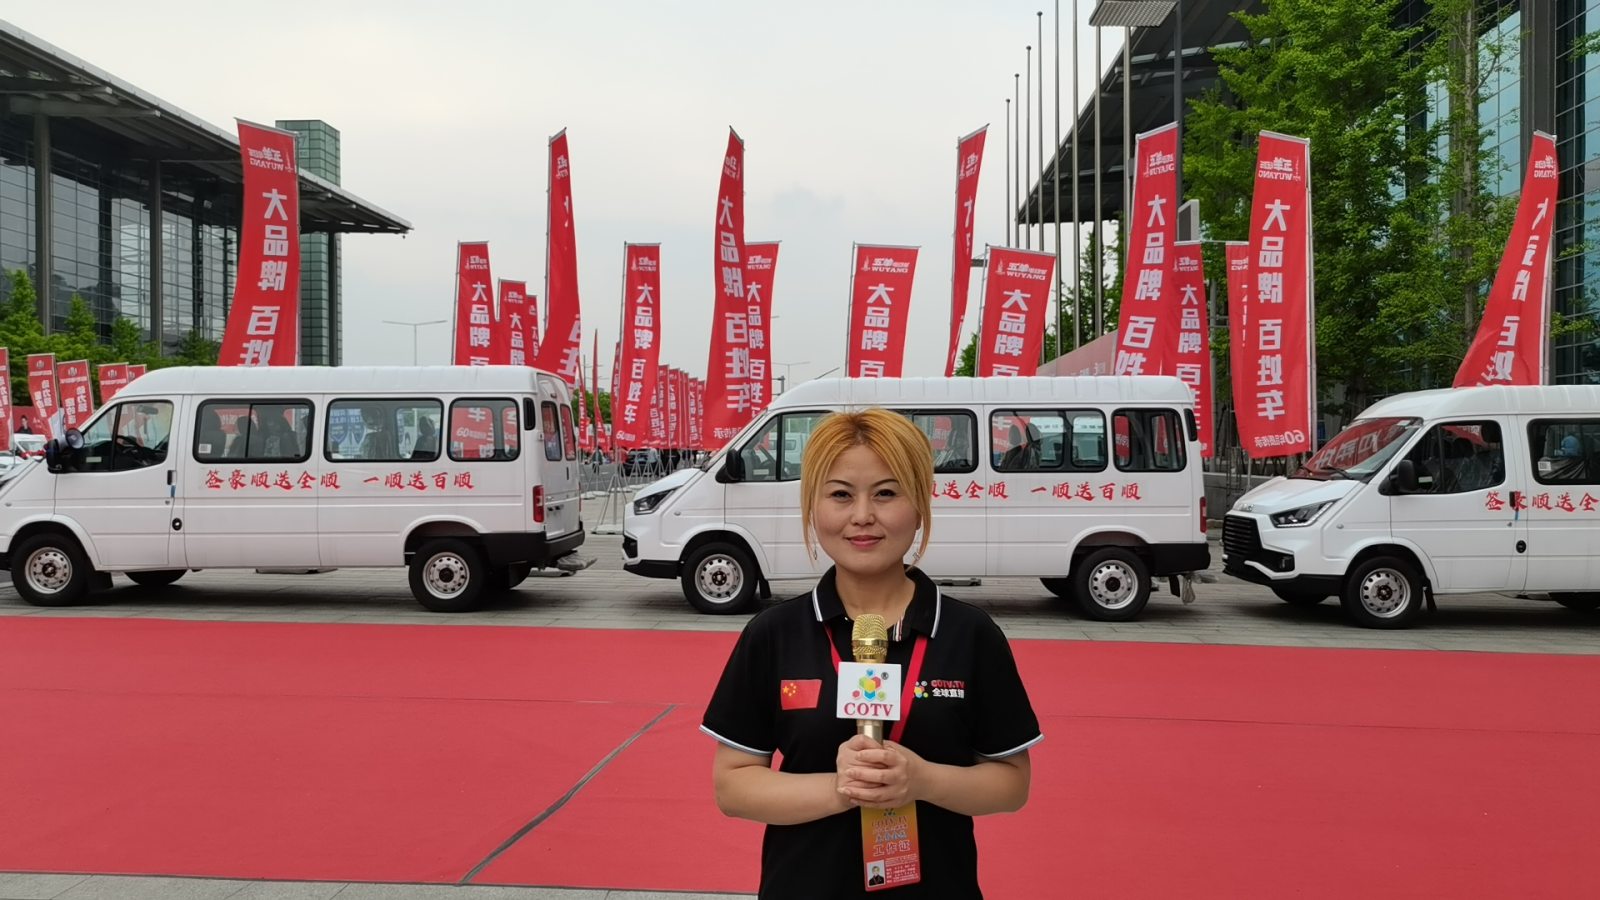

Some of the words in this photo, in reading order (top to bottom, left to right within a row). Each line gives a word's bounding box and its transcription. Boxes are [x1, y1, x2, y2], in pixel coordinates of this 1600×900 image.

[871, 266, 909, 274] WUYANG
[1006, 270, 1047, 280] WUYANG
[1135, 194, 1167, 301] 大品牌
[470, 281, 491, 348] 大品牌
[634, 282, 654, 350] 大品牌
[746, 281, 765, 349] 大品牌
[861, 283, 894, 352] 大品牌
[994, 289, 1031, 357] 大品牌
[1177, 284, 1202, 354] 大品牌
[623, 358, 647, 425] 百姓车
[362, 470, 475, 490] 一顺送百顺
[1030, 482, 1142, 501] 一顺送百顺
[844, 702, 893, 716] COTV
[931, 680, 965, 689] COTV.TV
